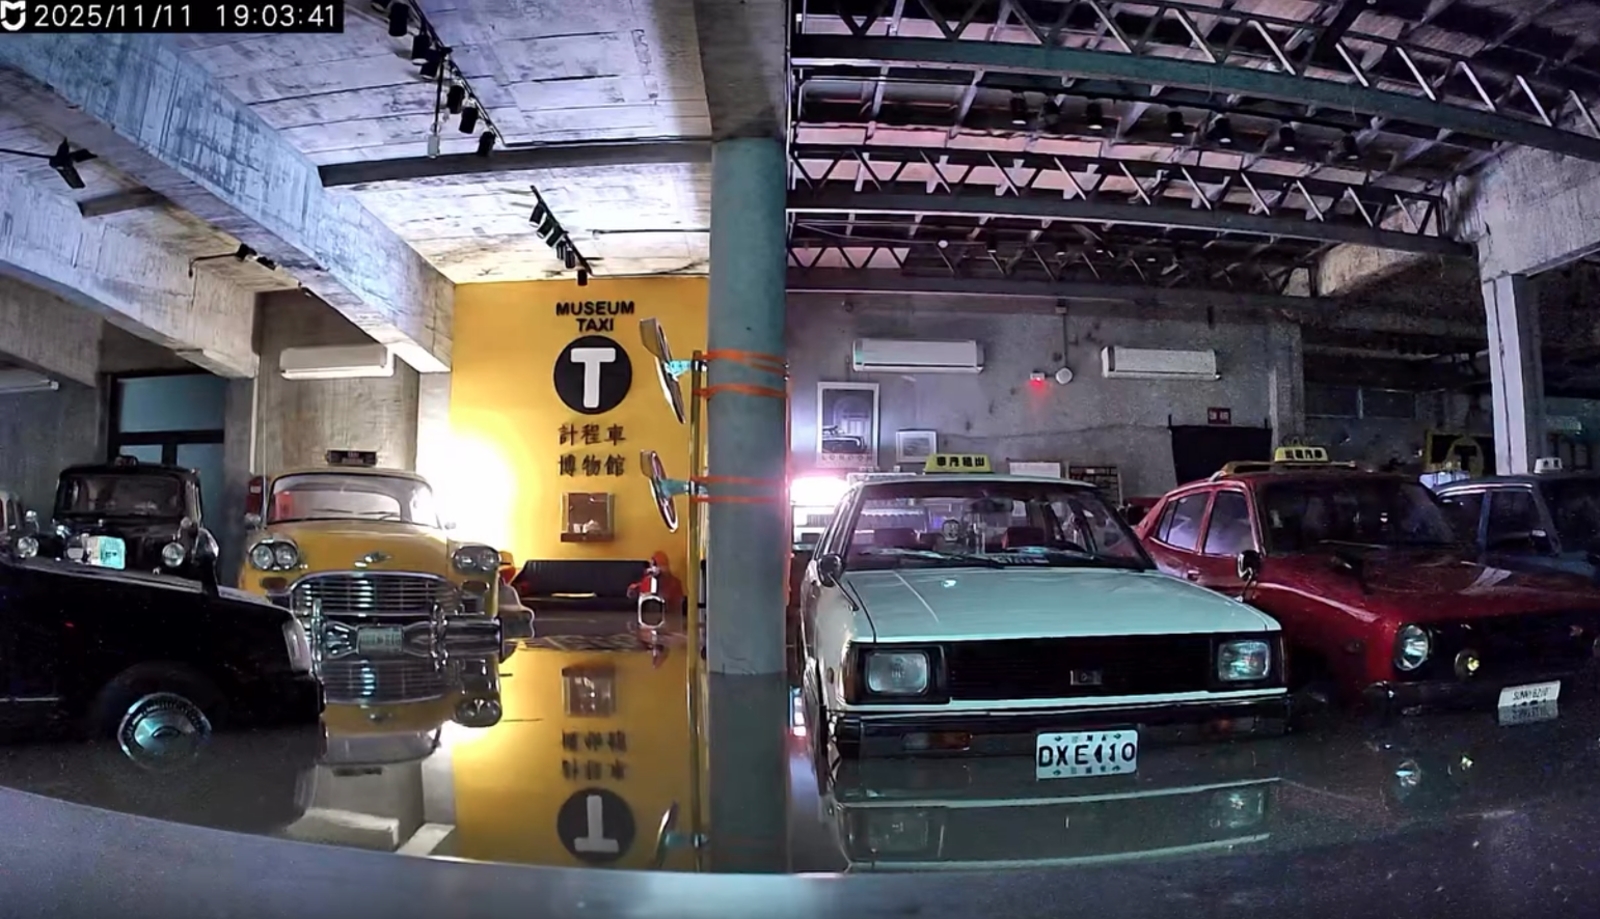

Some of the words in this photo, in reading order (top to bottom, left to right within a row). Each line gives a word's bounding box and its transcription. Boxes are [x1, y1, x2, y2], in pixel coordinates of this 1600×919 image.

[556, 301, 635, 316] MUSEUM
[576, 318, 614, 332] TAXI
[570, 348, 616, 408] T
[558, 424, 626, 446] 計程車
[558, 454, 626, 477] 博物館
